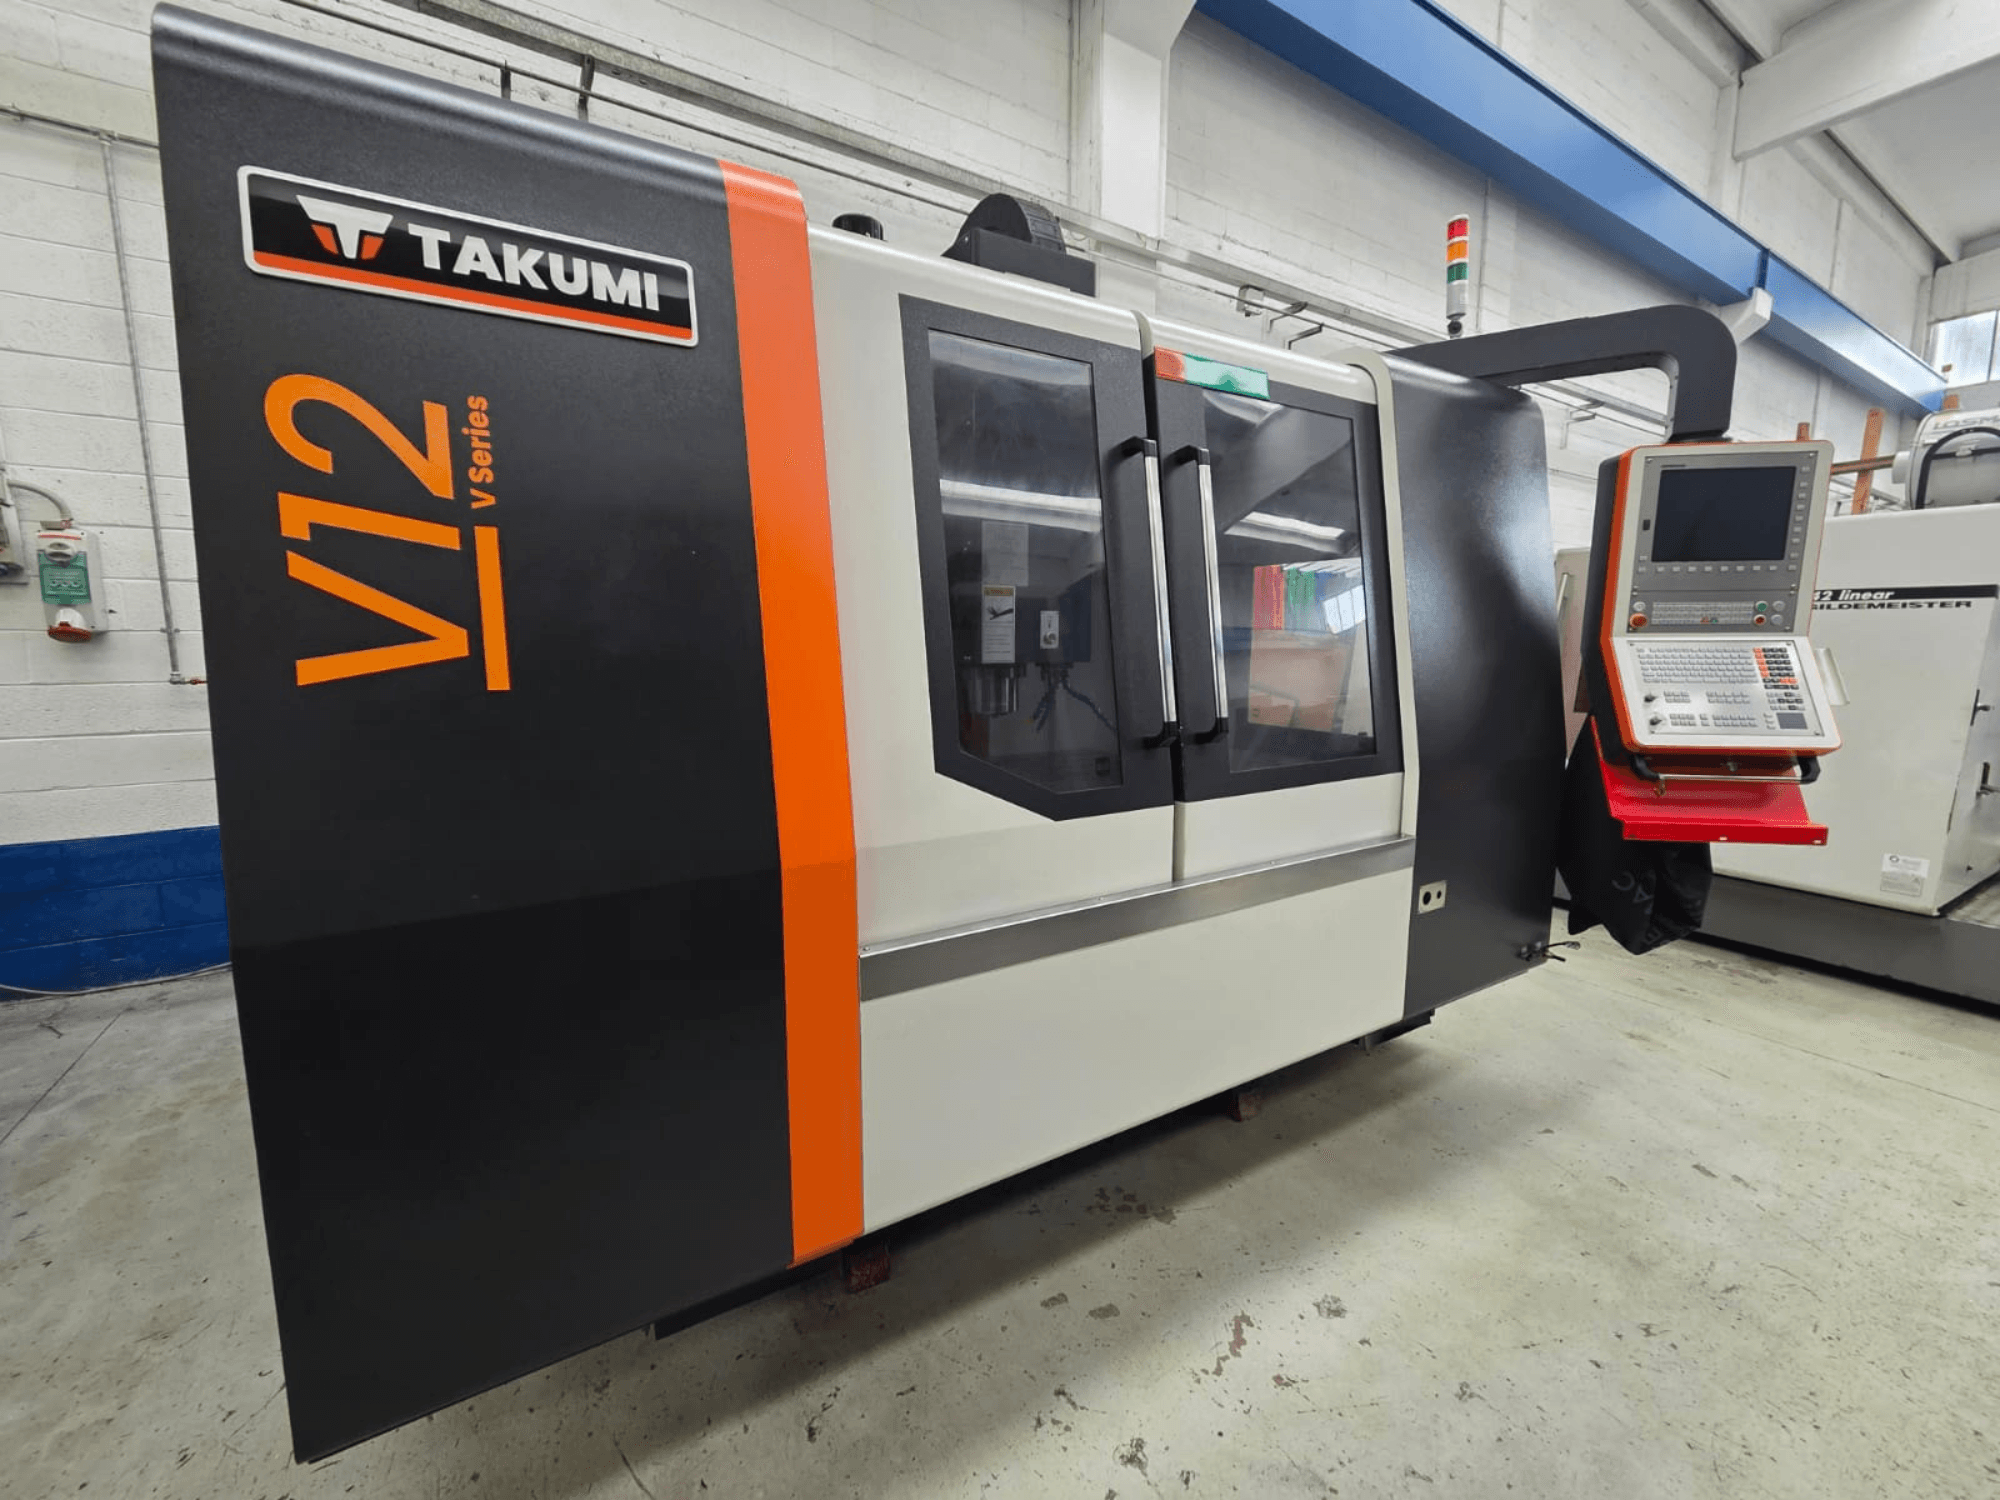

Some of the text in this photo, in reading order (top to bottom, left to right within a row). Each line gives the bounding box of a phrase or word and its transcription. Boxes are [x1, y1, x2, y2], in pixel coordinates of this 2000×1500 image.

[407, 223, 660, 312] TAKUMI
[460, 395, 497, 510] V Series
[264, 373, 470, 686] V12
[1838, 589, 1895, 601] linear
